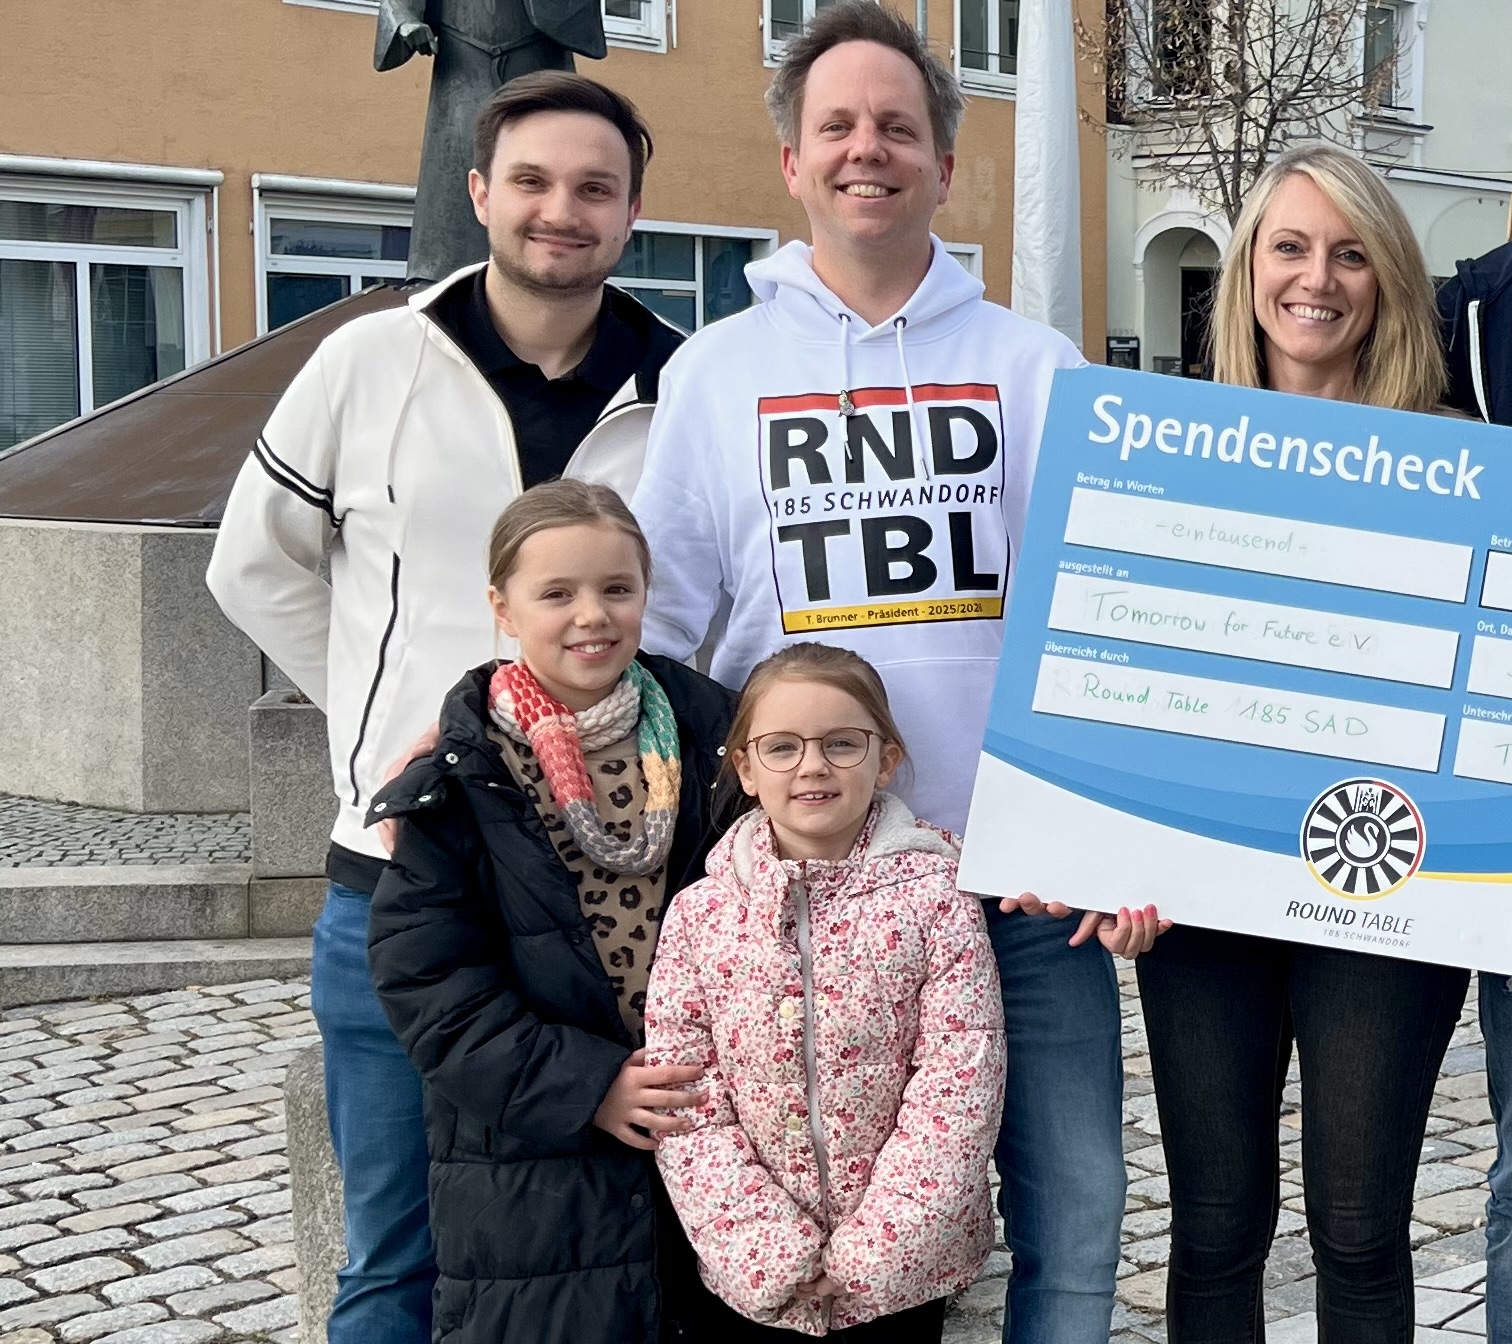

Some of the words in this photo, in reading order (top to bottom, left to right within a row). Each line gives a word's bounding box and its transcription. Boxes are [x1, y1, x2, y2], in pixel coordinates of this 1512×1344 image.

[769, 405, 998, 491] RND
[1087, 394, 1485, 500] Spendenscheck
[772, 500, 812, 519] 185
[823, 483, 999, 512] SCHWANDORF
[1076, 471, 1110, 490] Betrag
[1113, 477, 1123, 489] in
[1126, 479, 1165, 495] Worten
[775, 511, 999, 602] TBL
[1058, 559, 1113, 577] ausgestellt
[1115, 568, 1130, 579] an
[805, 615, 815, 625] T.
[816, 612, 858, 624] Brunner
[867, 608, 919, 621] Präsident
[1090, 590, 1207, 632] Tomorrow
[1223, 610, 1249, 636] for
[1262, 619, 1320, 645] Future
[1476, 621, 1497, 635] Ort,
[1044, 640, 1098, 659] überreicht
[1100, 649, 1130, 664] durch
[1083, 672, 1151, 705] Round
[1167, 690, 1209, 714] Table
[1238, 700, 1292, 725] 185
[1302, 709, 1369, 736] SAD
[1285, 900, 1357, 926] ROUND
[1361, 911, 1416, 936] TABLE
[1323, 928, 1340, 938] 185
[1343, 930, 1412, 949] SCHWANDORF
